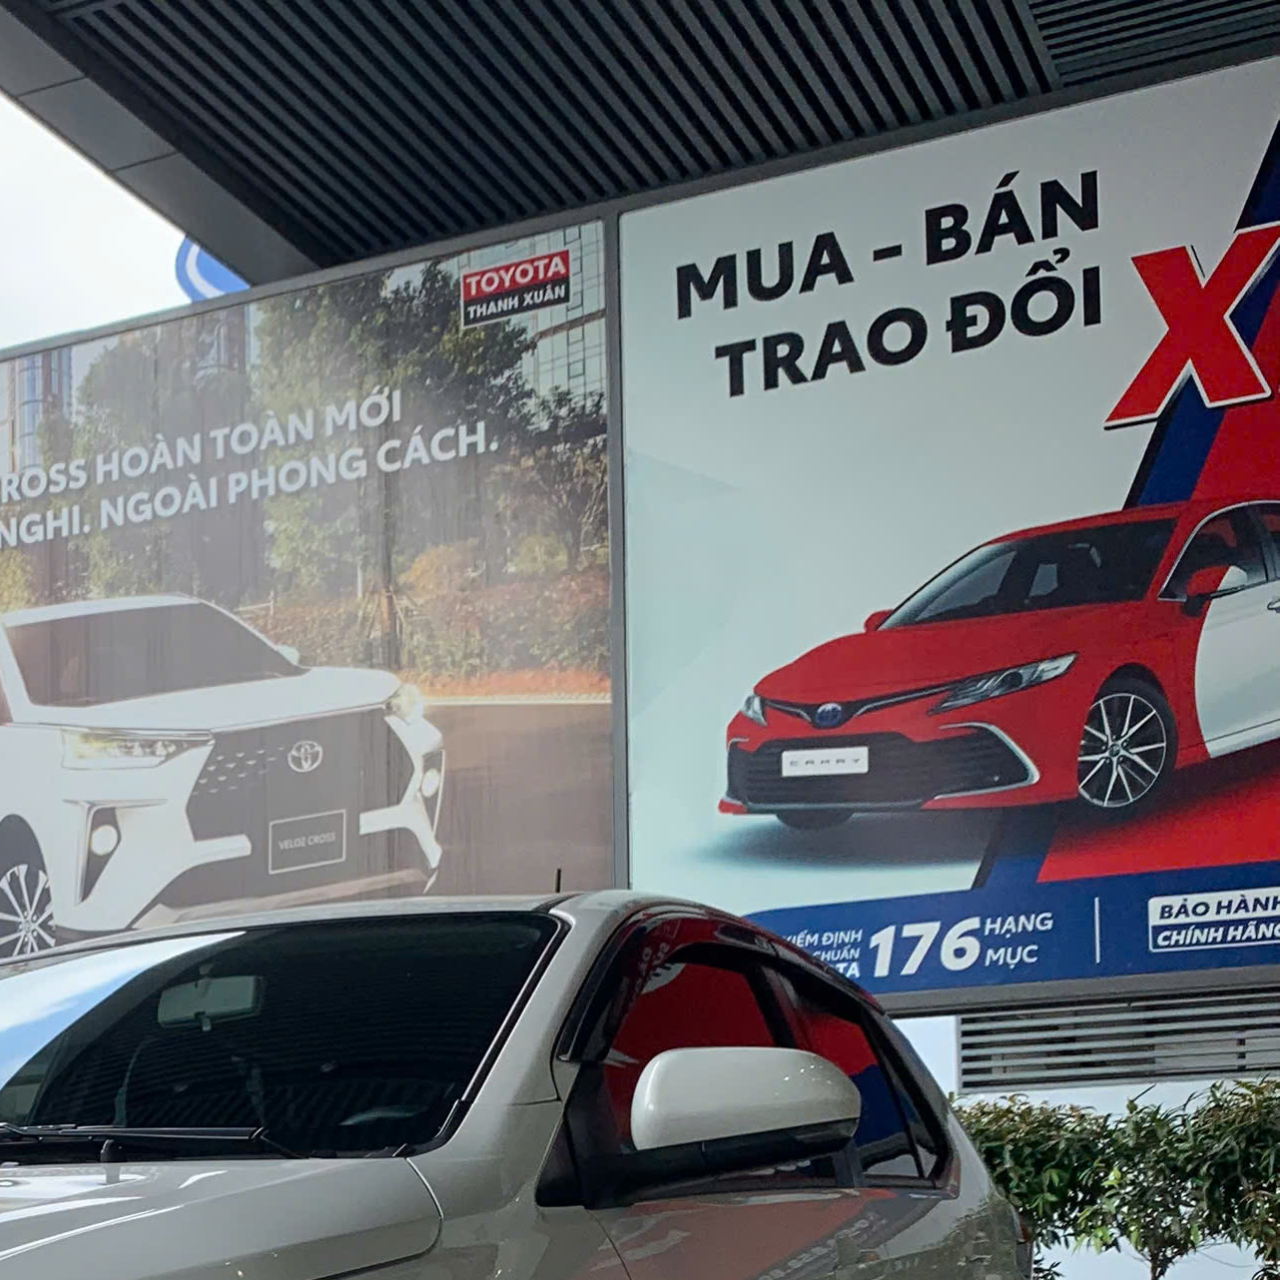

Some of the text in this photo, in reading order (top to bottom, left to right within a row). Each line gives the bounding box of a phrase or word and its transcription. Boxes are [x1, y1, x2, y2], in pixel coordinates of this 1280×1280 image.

[676, 170, 1099, 320] MUA - BÁN
[466, 256, 566, 296] TOYOTA
[467, 284, 565, 319] THANH XUÂN
[715, 247, 1101, 397] TRAO ĐỔI
[96, 433, 202, 485] HOÀN
[210, 408, 313, 459] TOÀN
[325, 384, 402, 437] MỚI
[100, 474, 218, 530] NGOÀI
[228, 447, 367, 504] PHONG
[376, 421, 499, 473] CÁCH.
[1159, 898, 1210, 920] BẢO
[822, 929, 863, 948] ĐỊNH
[869, 912, 1054, 978] 176 HẠNG
[1157, 925, 1224, 946] CHÍNH
[985, 945, 1038, 969] MỤC
